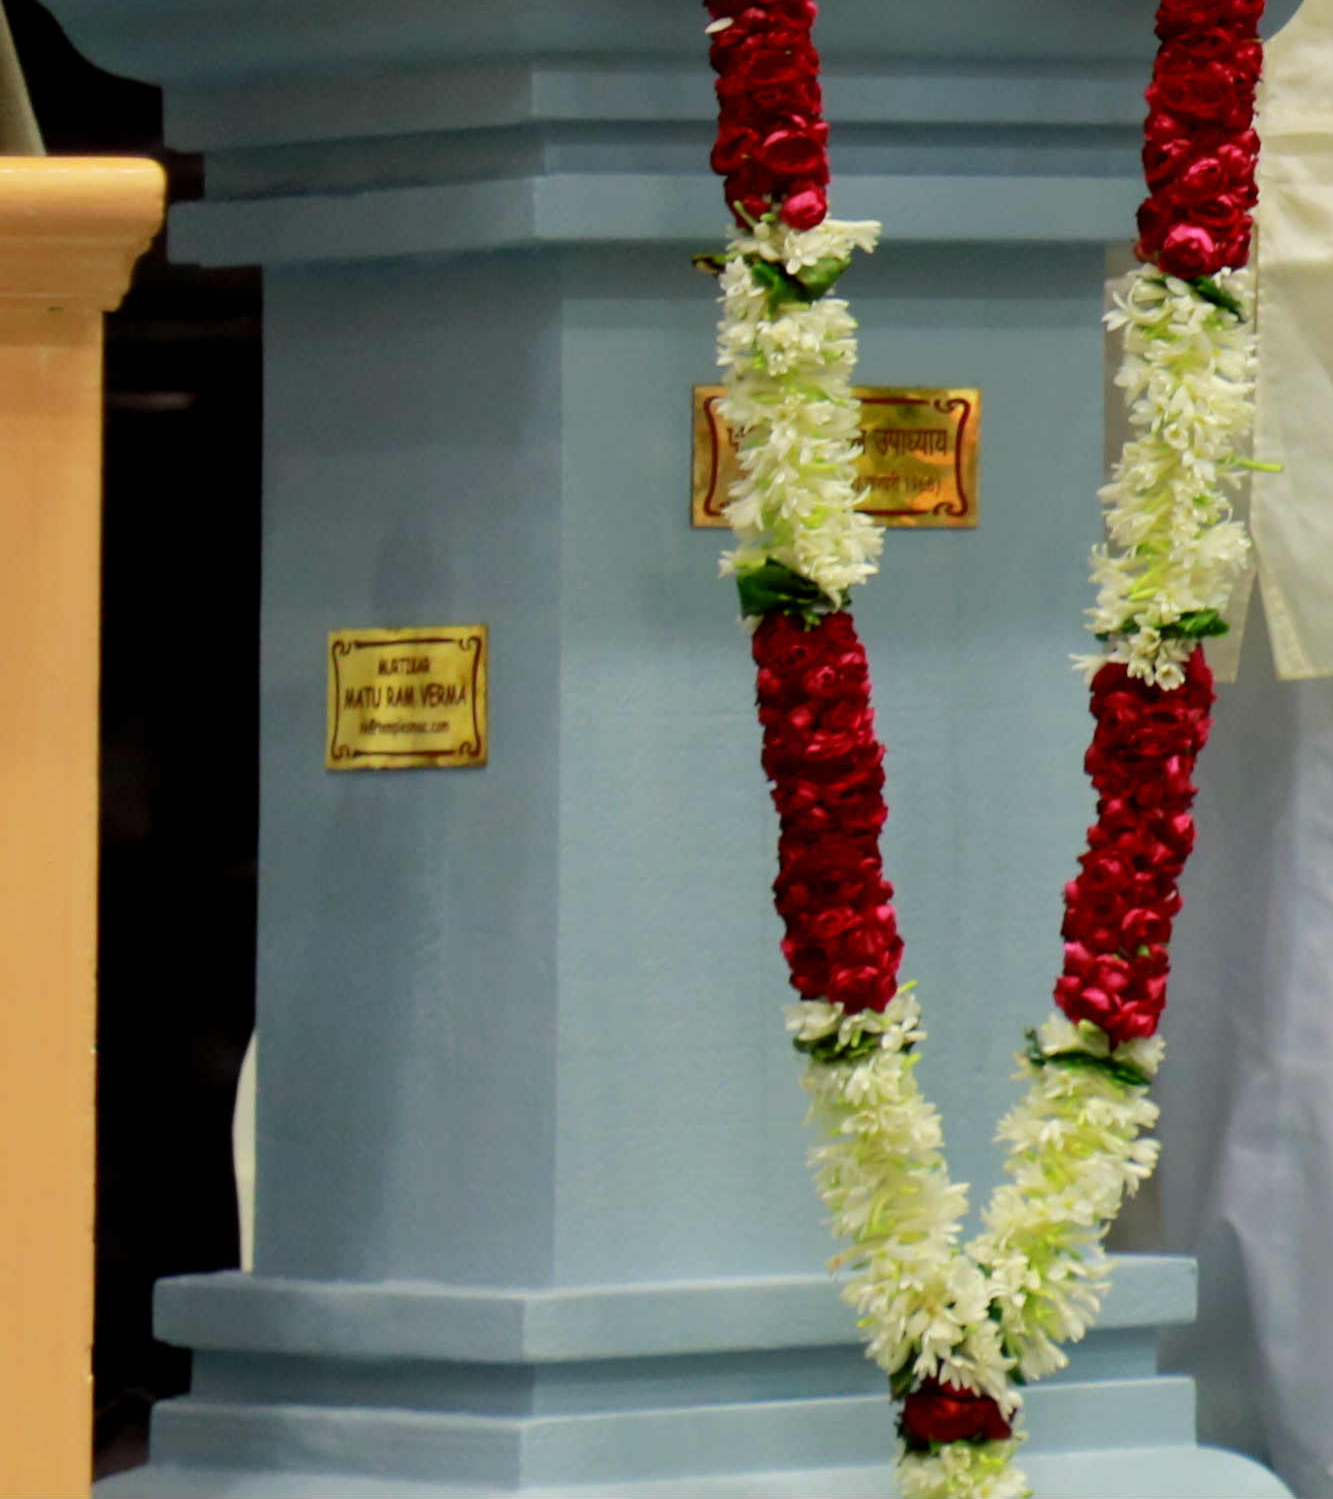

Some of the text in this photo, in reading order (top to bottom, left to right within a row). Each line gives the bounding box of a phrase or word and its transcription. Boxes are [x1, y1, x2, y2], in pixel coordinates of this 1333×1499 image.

[872, 429, 948, 456] उपाध्याय
[344, 682, 466, 709] MATU RAM VERMA
